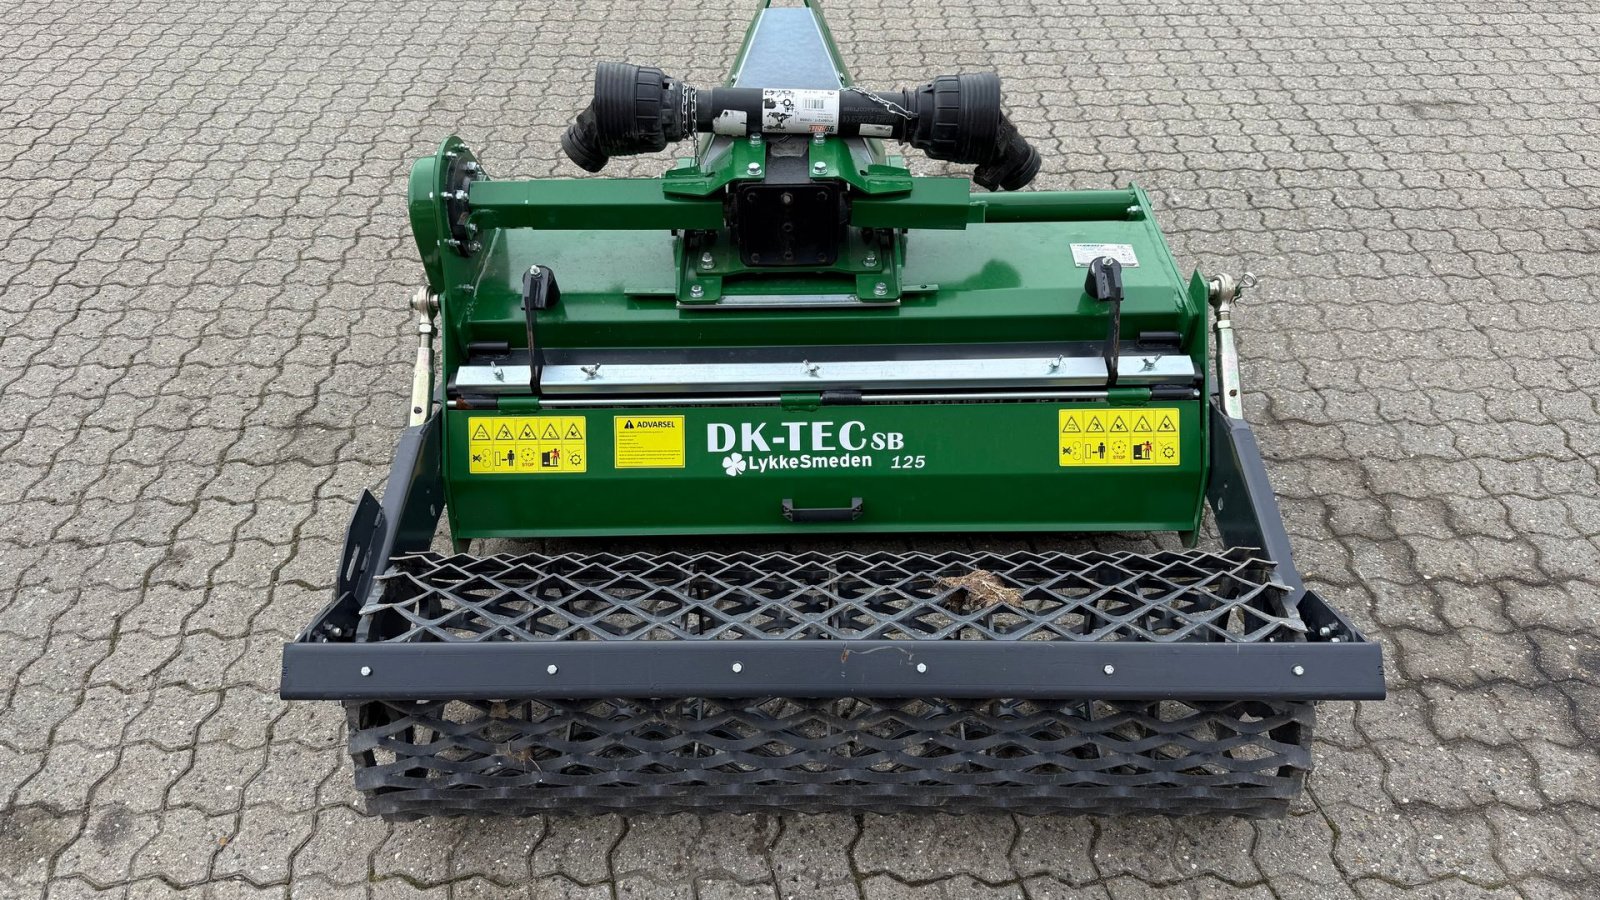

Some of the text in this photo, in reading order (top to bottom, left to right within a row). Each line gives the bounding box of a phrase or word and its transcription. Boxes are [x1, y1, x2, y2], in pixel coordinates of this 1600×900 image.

[706, 420, 867, 453] DK-TEC
[870, 432, 905, 451] SB
[748, 453, 926, 473] LykkeSmeden 125
